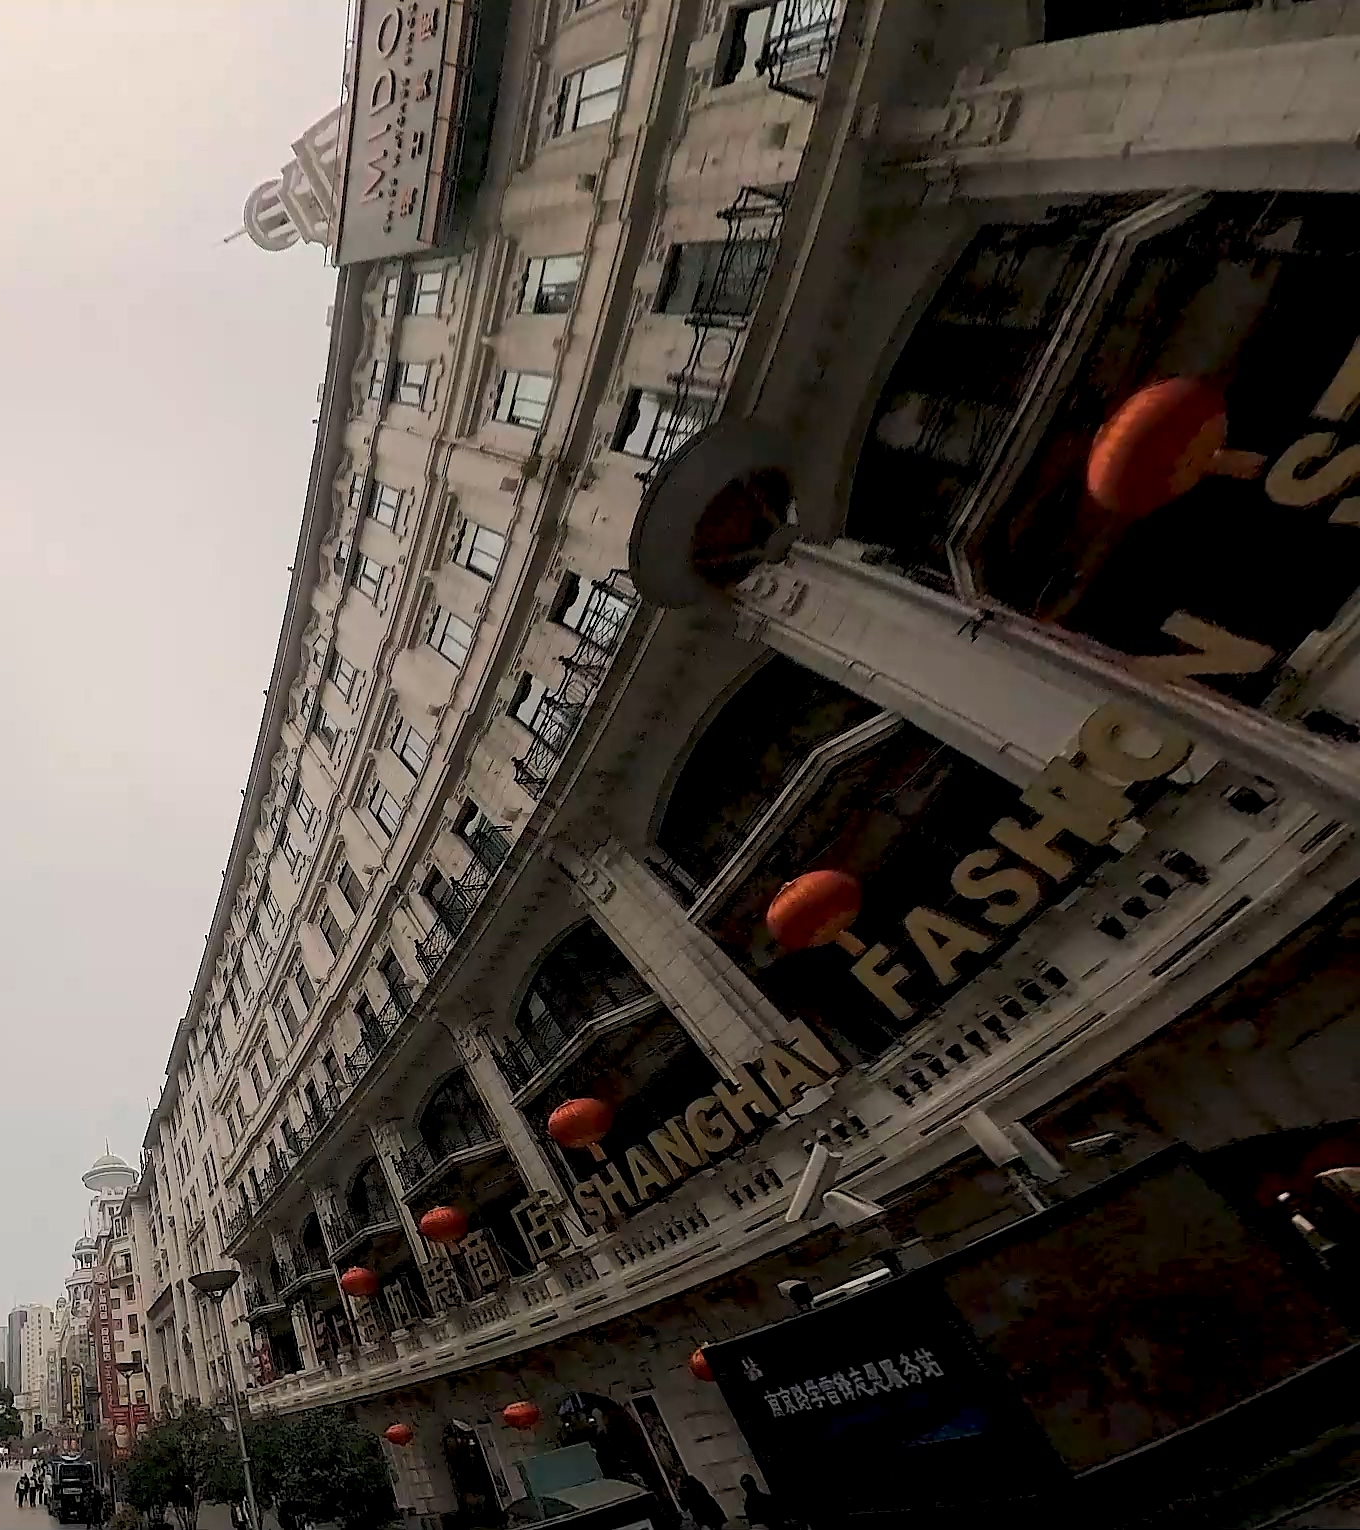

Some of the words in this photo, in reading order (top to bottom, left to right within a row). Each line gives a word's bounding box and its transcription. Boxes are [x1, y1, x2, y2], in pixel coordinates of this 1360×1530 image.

[361, 5, 403, 205] MIDO
[574, 1017, 843, 1227] SHANGHAI
[851, 609, 1275, 1020] FASHION
